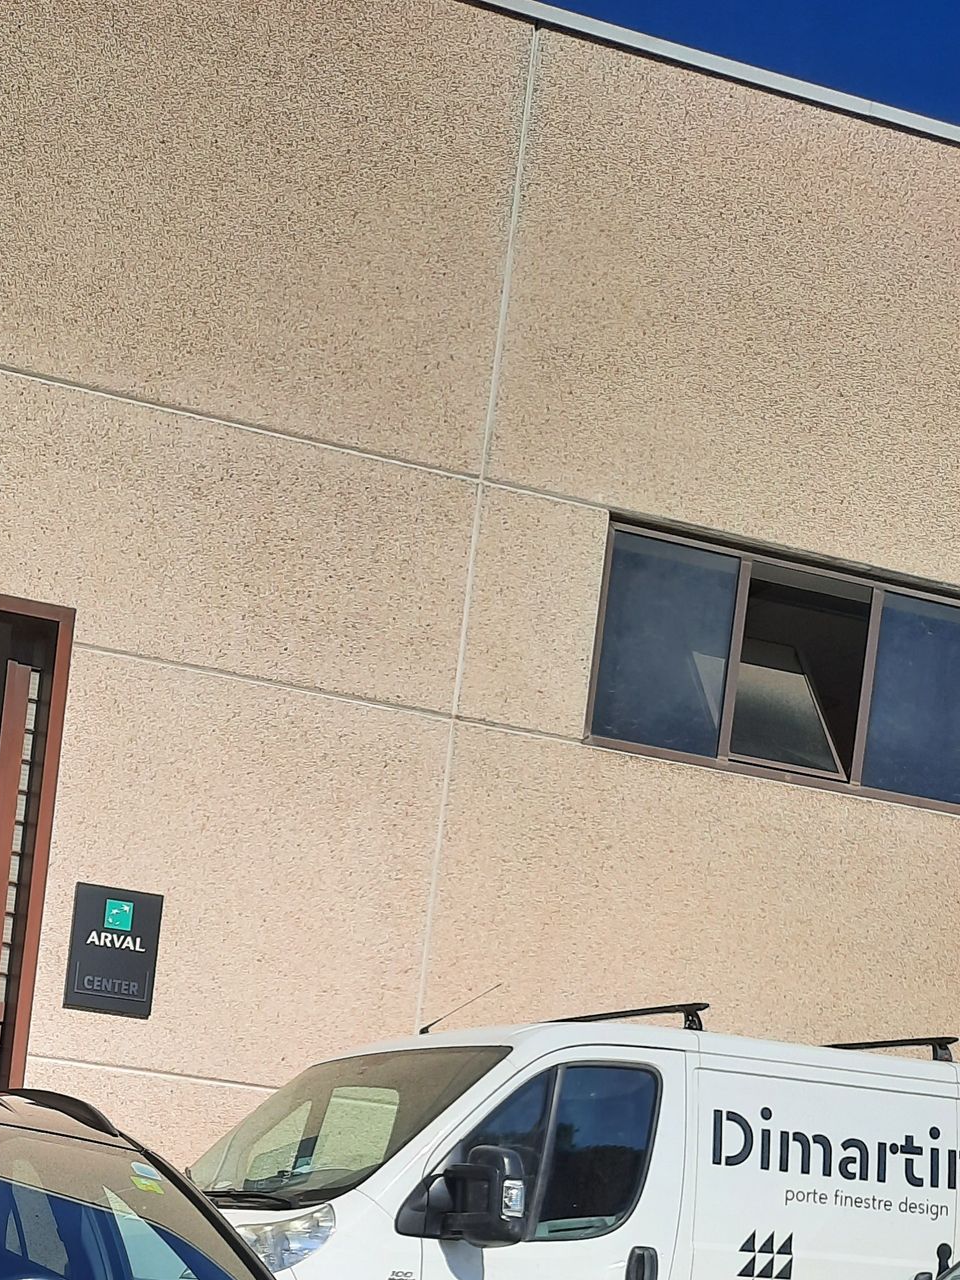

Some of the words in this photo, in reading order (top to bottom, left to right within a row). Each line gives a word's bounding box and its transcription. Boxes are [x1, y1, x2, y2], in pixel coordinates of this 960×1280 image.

[86, 930, 146, 953] ARVAL
[83, 975, 139, 996] CENTER
[785, 1188, 828, 1206] porte
[834, 1190, 893, 1212] finestre
[898, 1196, 949, 1221] design
